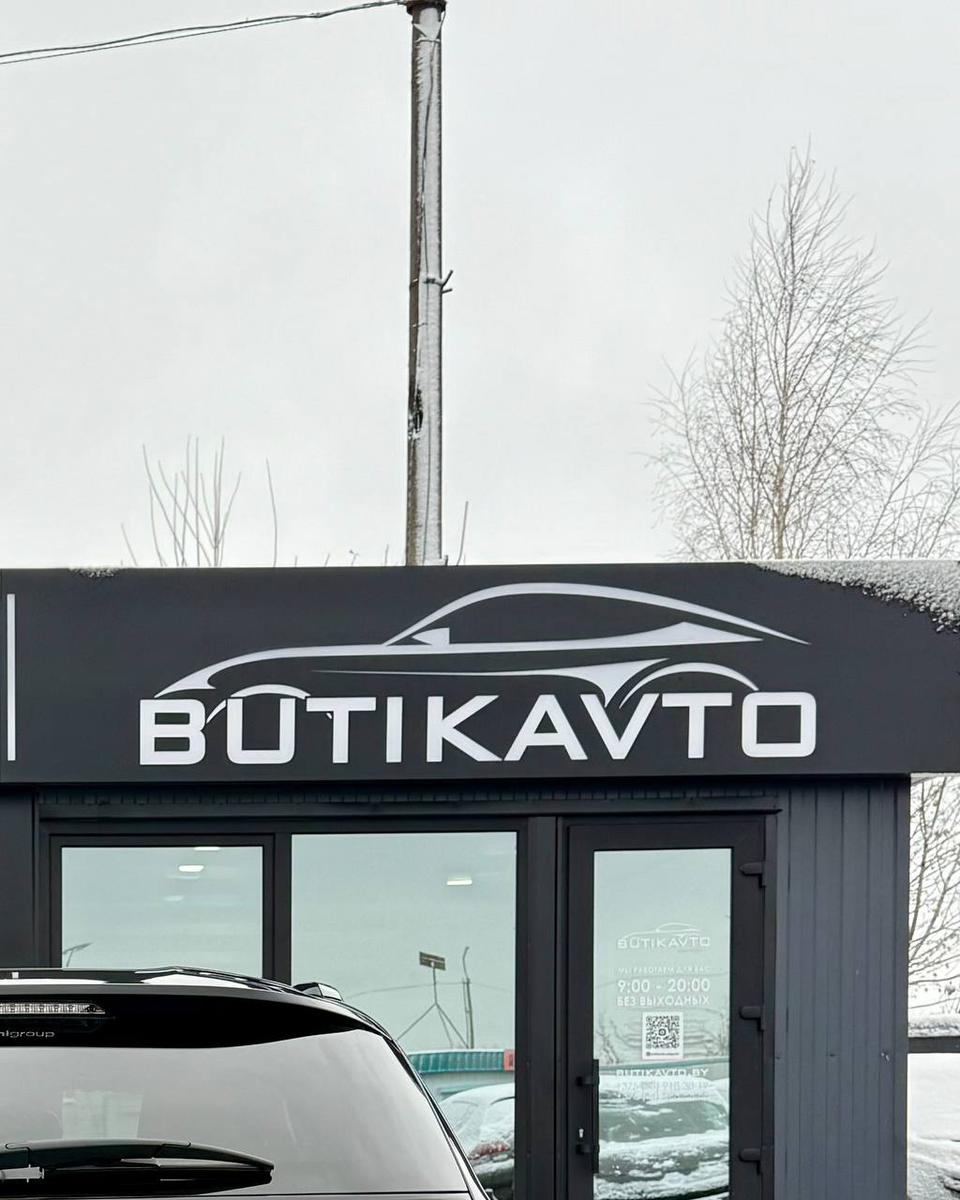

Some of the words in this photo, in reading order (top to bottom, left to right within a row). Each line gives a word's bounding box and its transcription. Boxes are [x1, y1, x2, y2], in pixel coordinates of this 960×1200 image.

[139, 691, 817, 766] BUTIKAVTO
[617, 979, 651, 993] 9:00
[667, 977, 711, 992] 20:00
